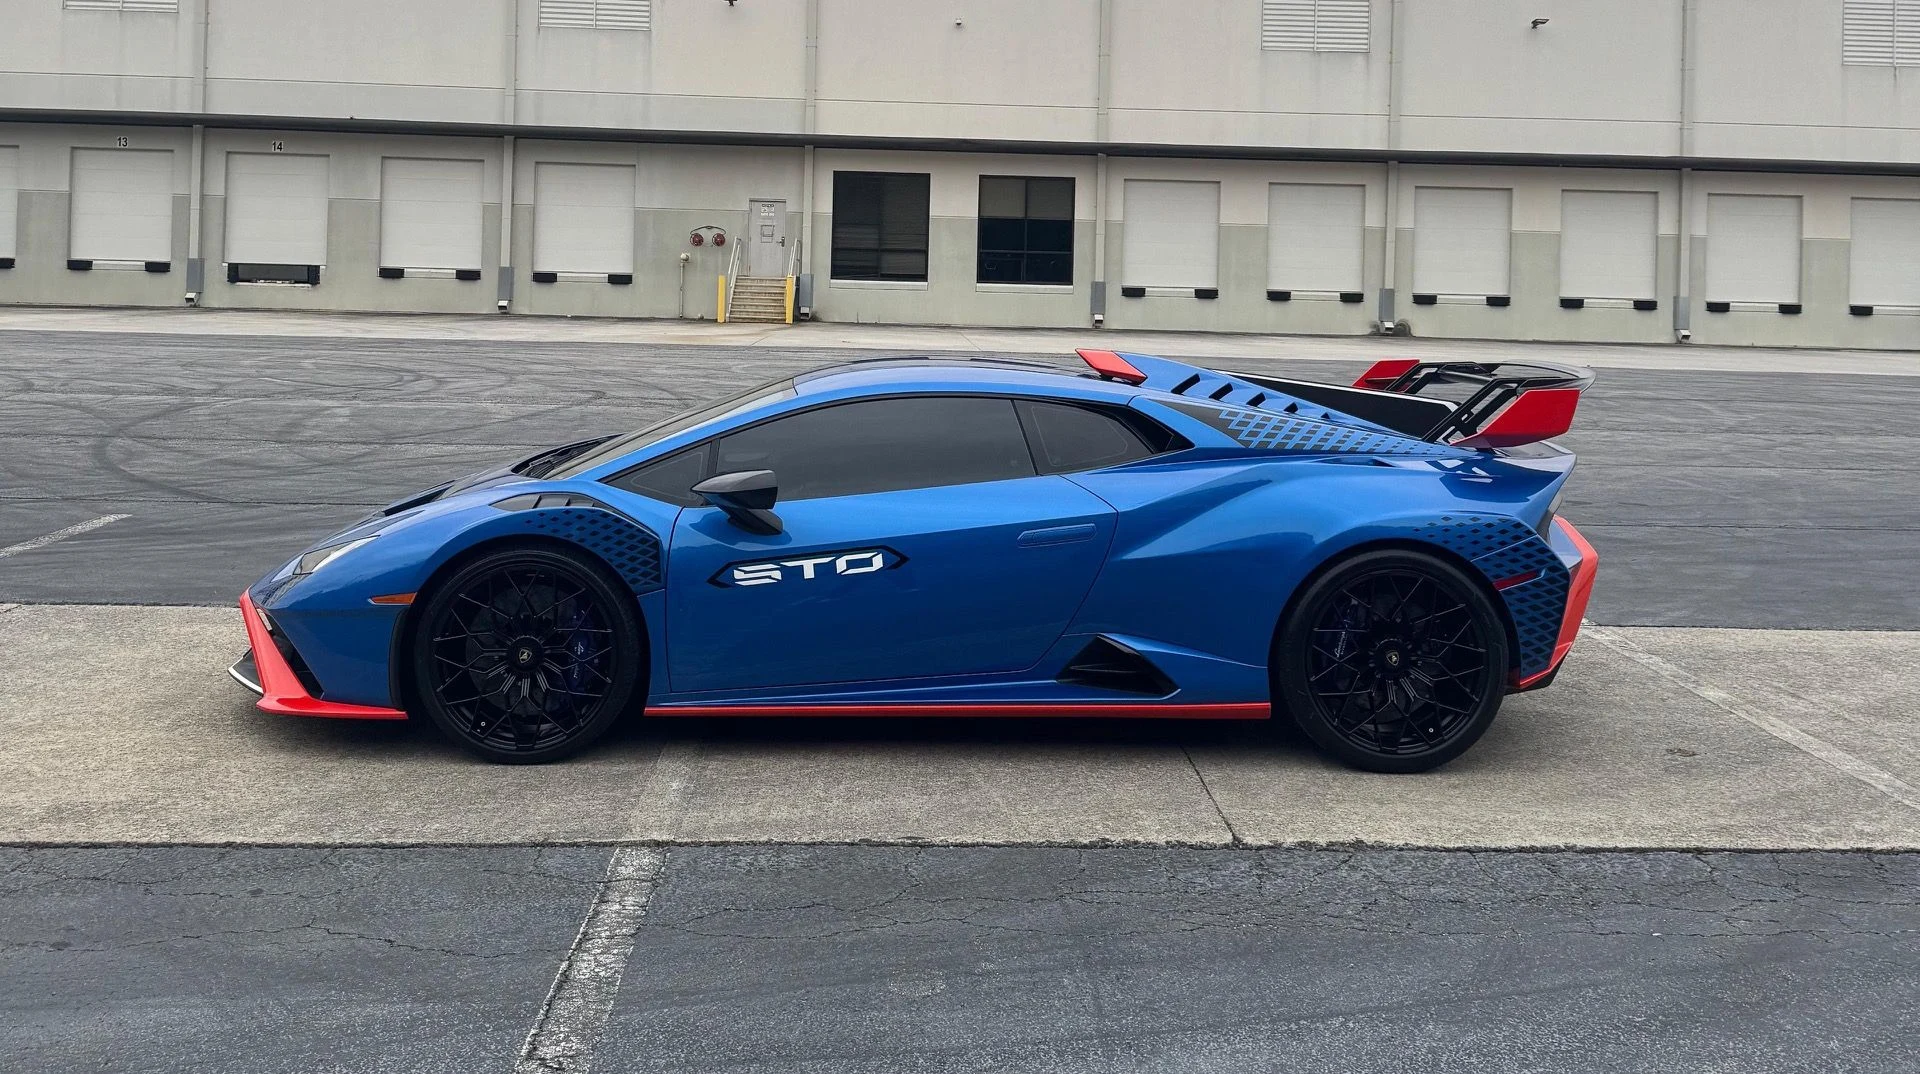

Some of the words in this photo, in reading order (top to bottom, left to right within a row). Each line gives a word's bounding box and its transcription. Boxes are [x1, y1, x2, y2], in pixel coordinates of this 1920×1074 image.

[117, 136, 128, 147] 13
[272, 141, 283, 152] 14
[733, 551, 884, 586] STO
